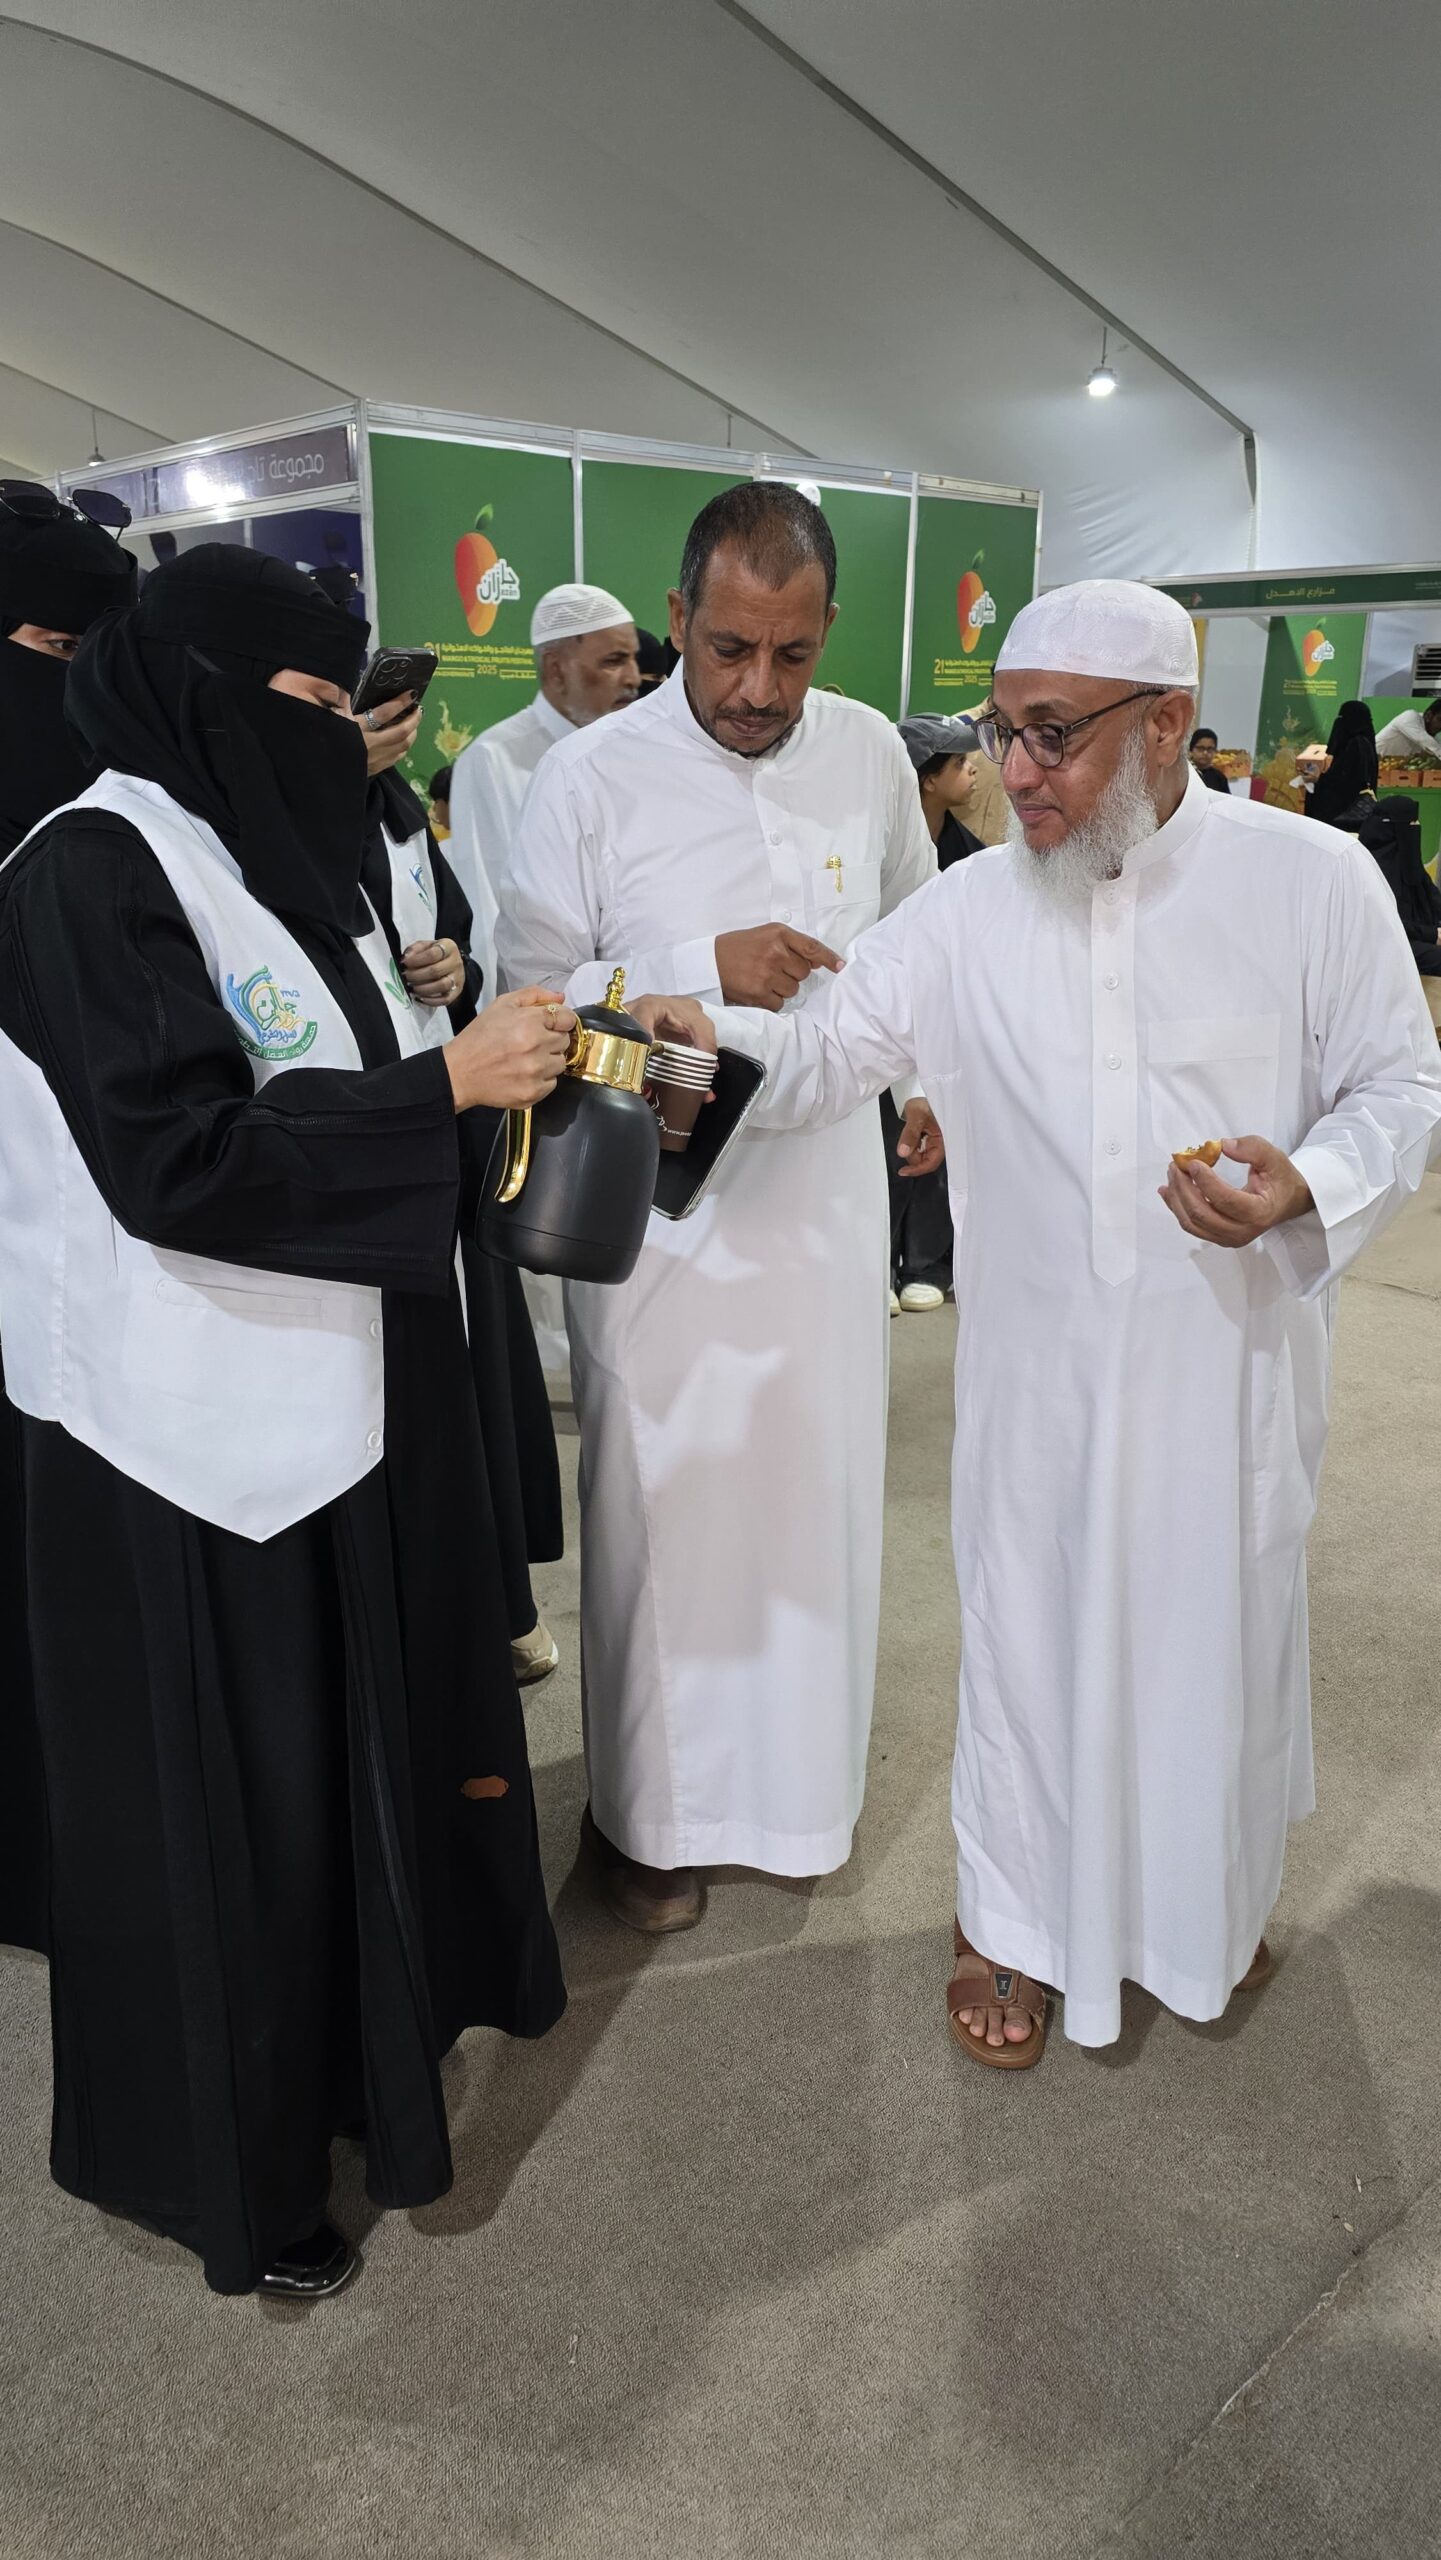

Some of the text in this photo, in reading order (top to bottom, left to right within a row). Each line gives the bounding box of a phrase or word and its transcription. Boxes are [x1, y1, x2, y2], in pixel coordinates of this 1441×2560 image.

[269, 453, 325, 483] مجموعة
[478, 560, 518, 602] جازان
[477, 664, 498, 675] 2025
[934, 658, 945, 674] 21
